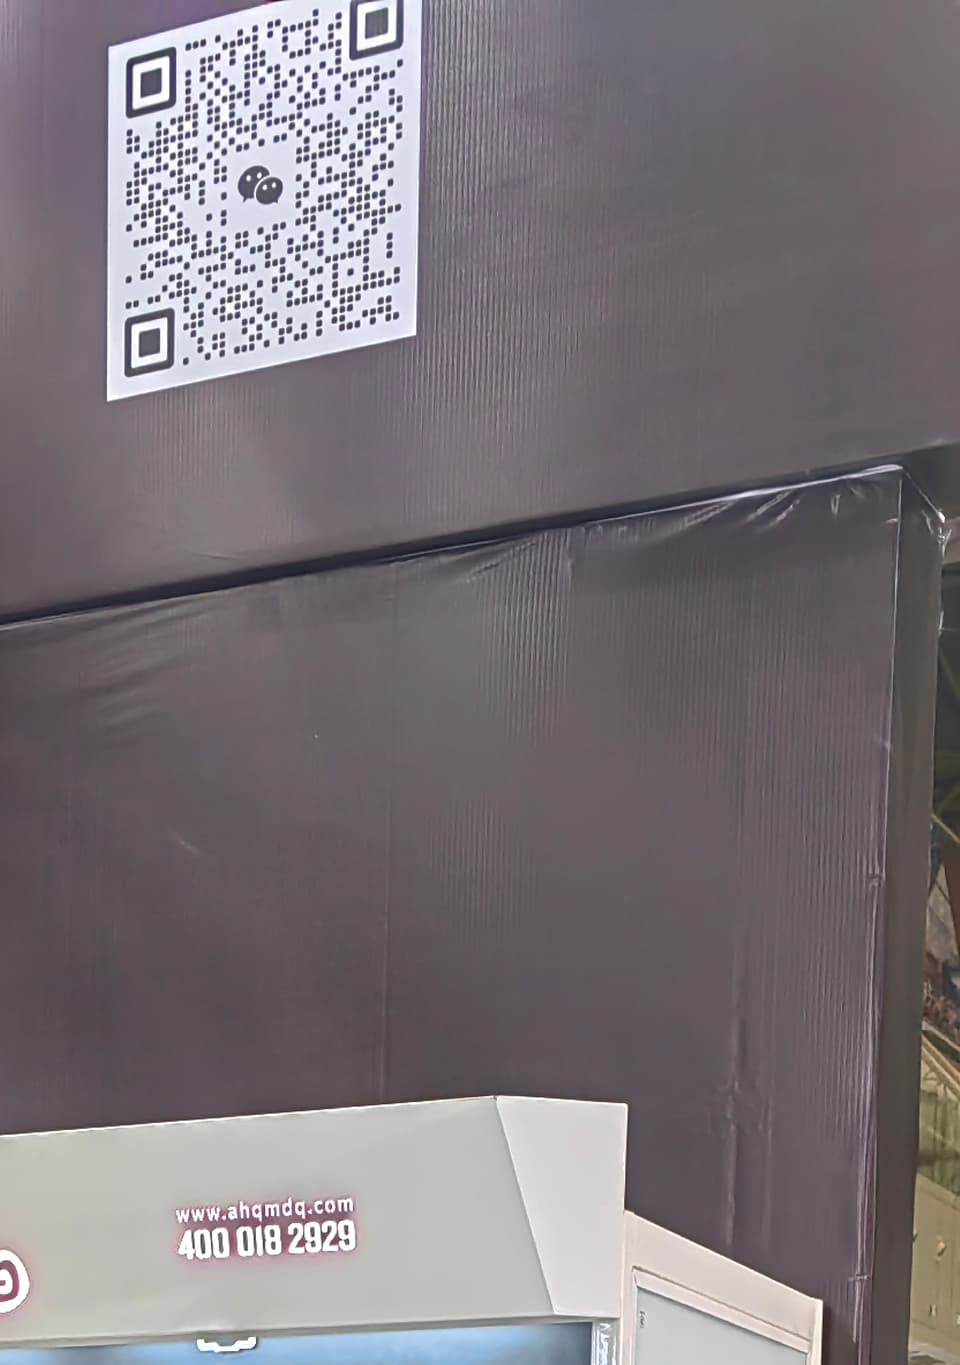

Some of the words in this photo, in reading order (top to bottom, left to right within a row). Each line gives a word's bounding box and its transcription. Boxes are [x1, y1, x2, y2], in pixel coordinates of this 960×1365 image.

[175, 1197, 355, 1223] www.ahqmdq.com
[177, 1227, 230, 1260] 400
[236, 1224, 282, 1257] 018
[288, 1219, 356, 1254] 2929
